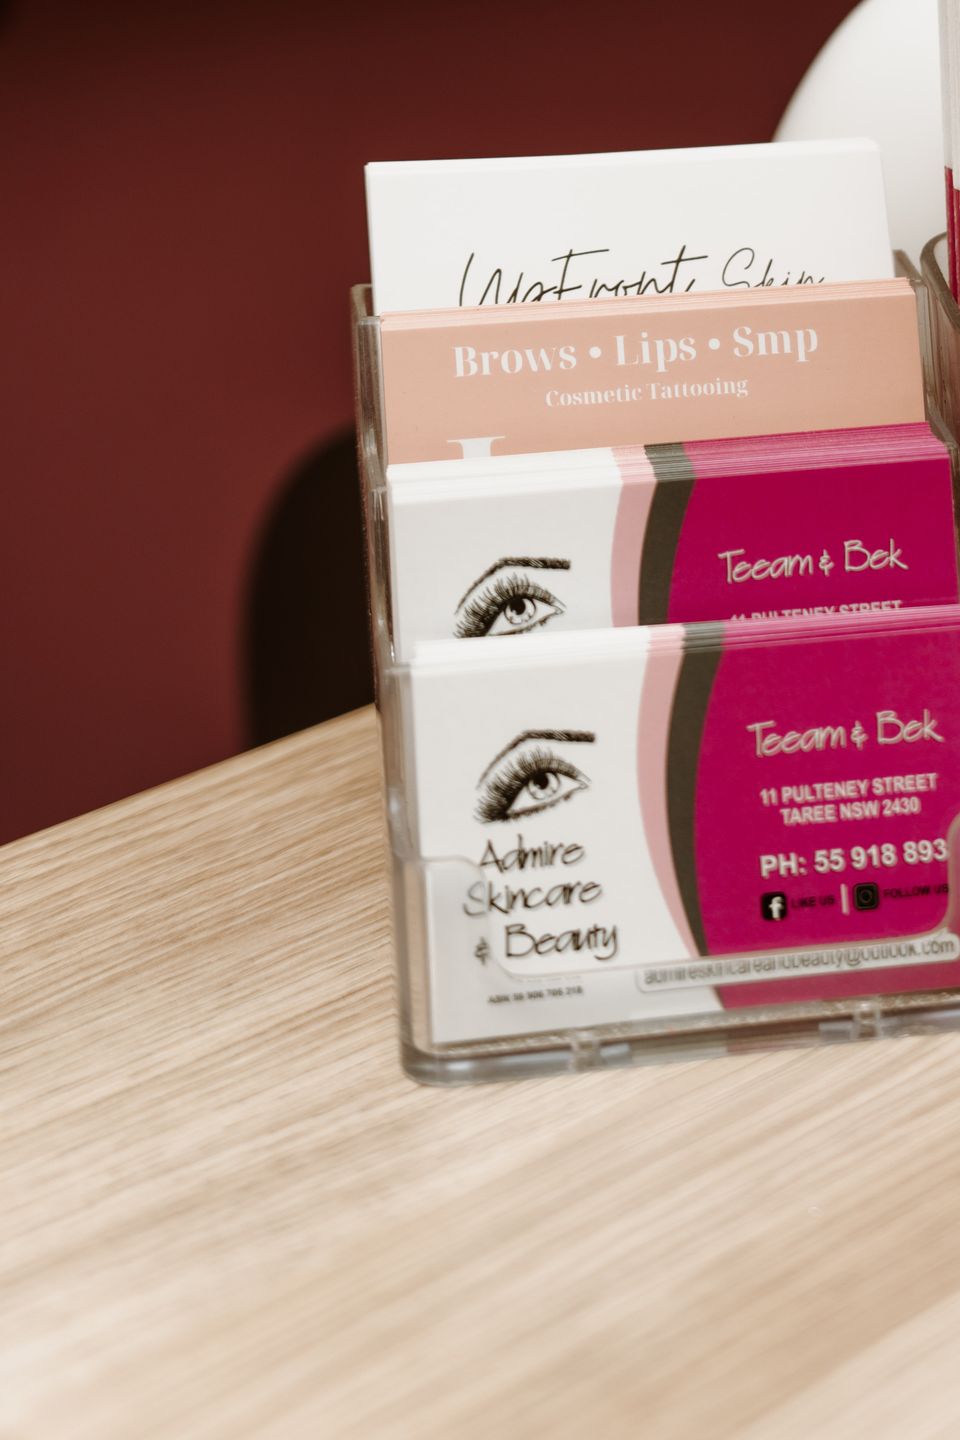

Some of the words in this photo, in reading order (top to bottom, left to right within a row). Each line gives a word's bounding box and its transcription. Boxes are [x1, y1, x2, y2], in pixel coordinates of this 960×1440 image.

[453, 343, 577, 378] Brows
[615, 331, 697, 373] Lips
[733, 325, 819, 364] Smp
[545, 383, 643, 407] Cosmetic
[648, 377, 749, 402] Tattooing
[718, 548, 814, 585] Teeam
[818, 547, 836, 577] &
[843, 537, 909, 573] Bek
[747, 720, 847, 757] Teeam
[851, 721, 867, 750] &
[876, 709, 944, 744] Bek
[760, 788, 777, 806] 11
[782, 779, 868, 804] PULTENEY
[873, 773, 937, 798] STREET
[780, 806, 837, 826] TAREE
[840, 801, 879, 821] NSW
[882, 797, 920, 816] 2430
[480, 833, 587, 873] Admire
[760, 853, 806, 878] PH:
[814, 848, 845, 874] 55
[851, 843, 897, 869] 918
[904, 838, 948, 863] 893
[462, 880, 602, 916] Skincare
[474, 936, 490, 964] &
[505, 923, 619, 961] Beauty
